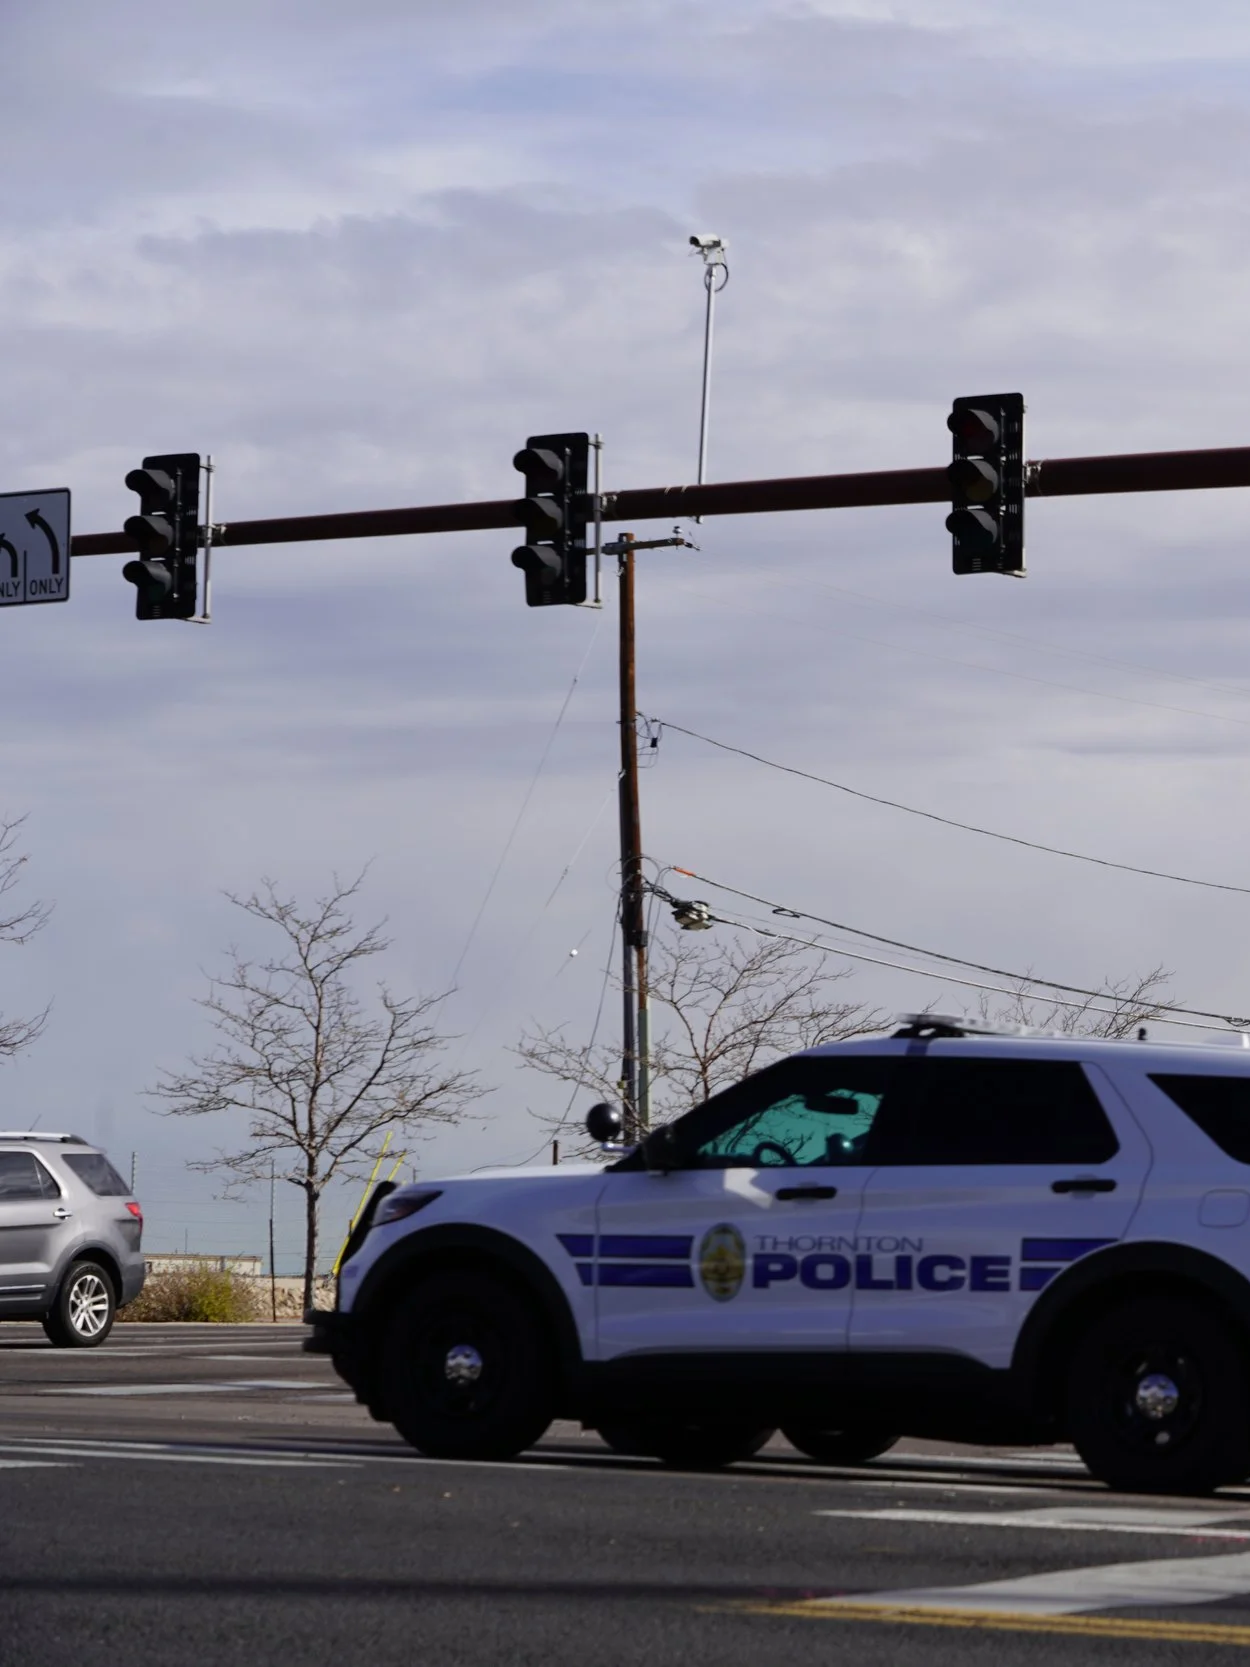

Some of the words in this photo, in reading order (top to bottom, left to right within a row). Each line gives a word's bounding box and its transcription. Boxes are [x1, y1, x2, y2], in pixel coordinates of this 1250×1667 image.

[0, 581, 20, 598] NLY
[30, 578, 64, 596] ONLY
[752, 1235, 924, 1253] THORNTON
[752, 1253, 1012, 1292] POLICE
